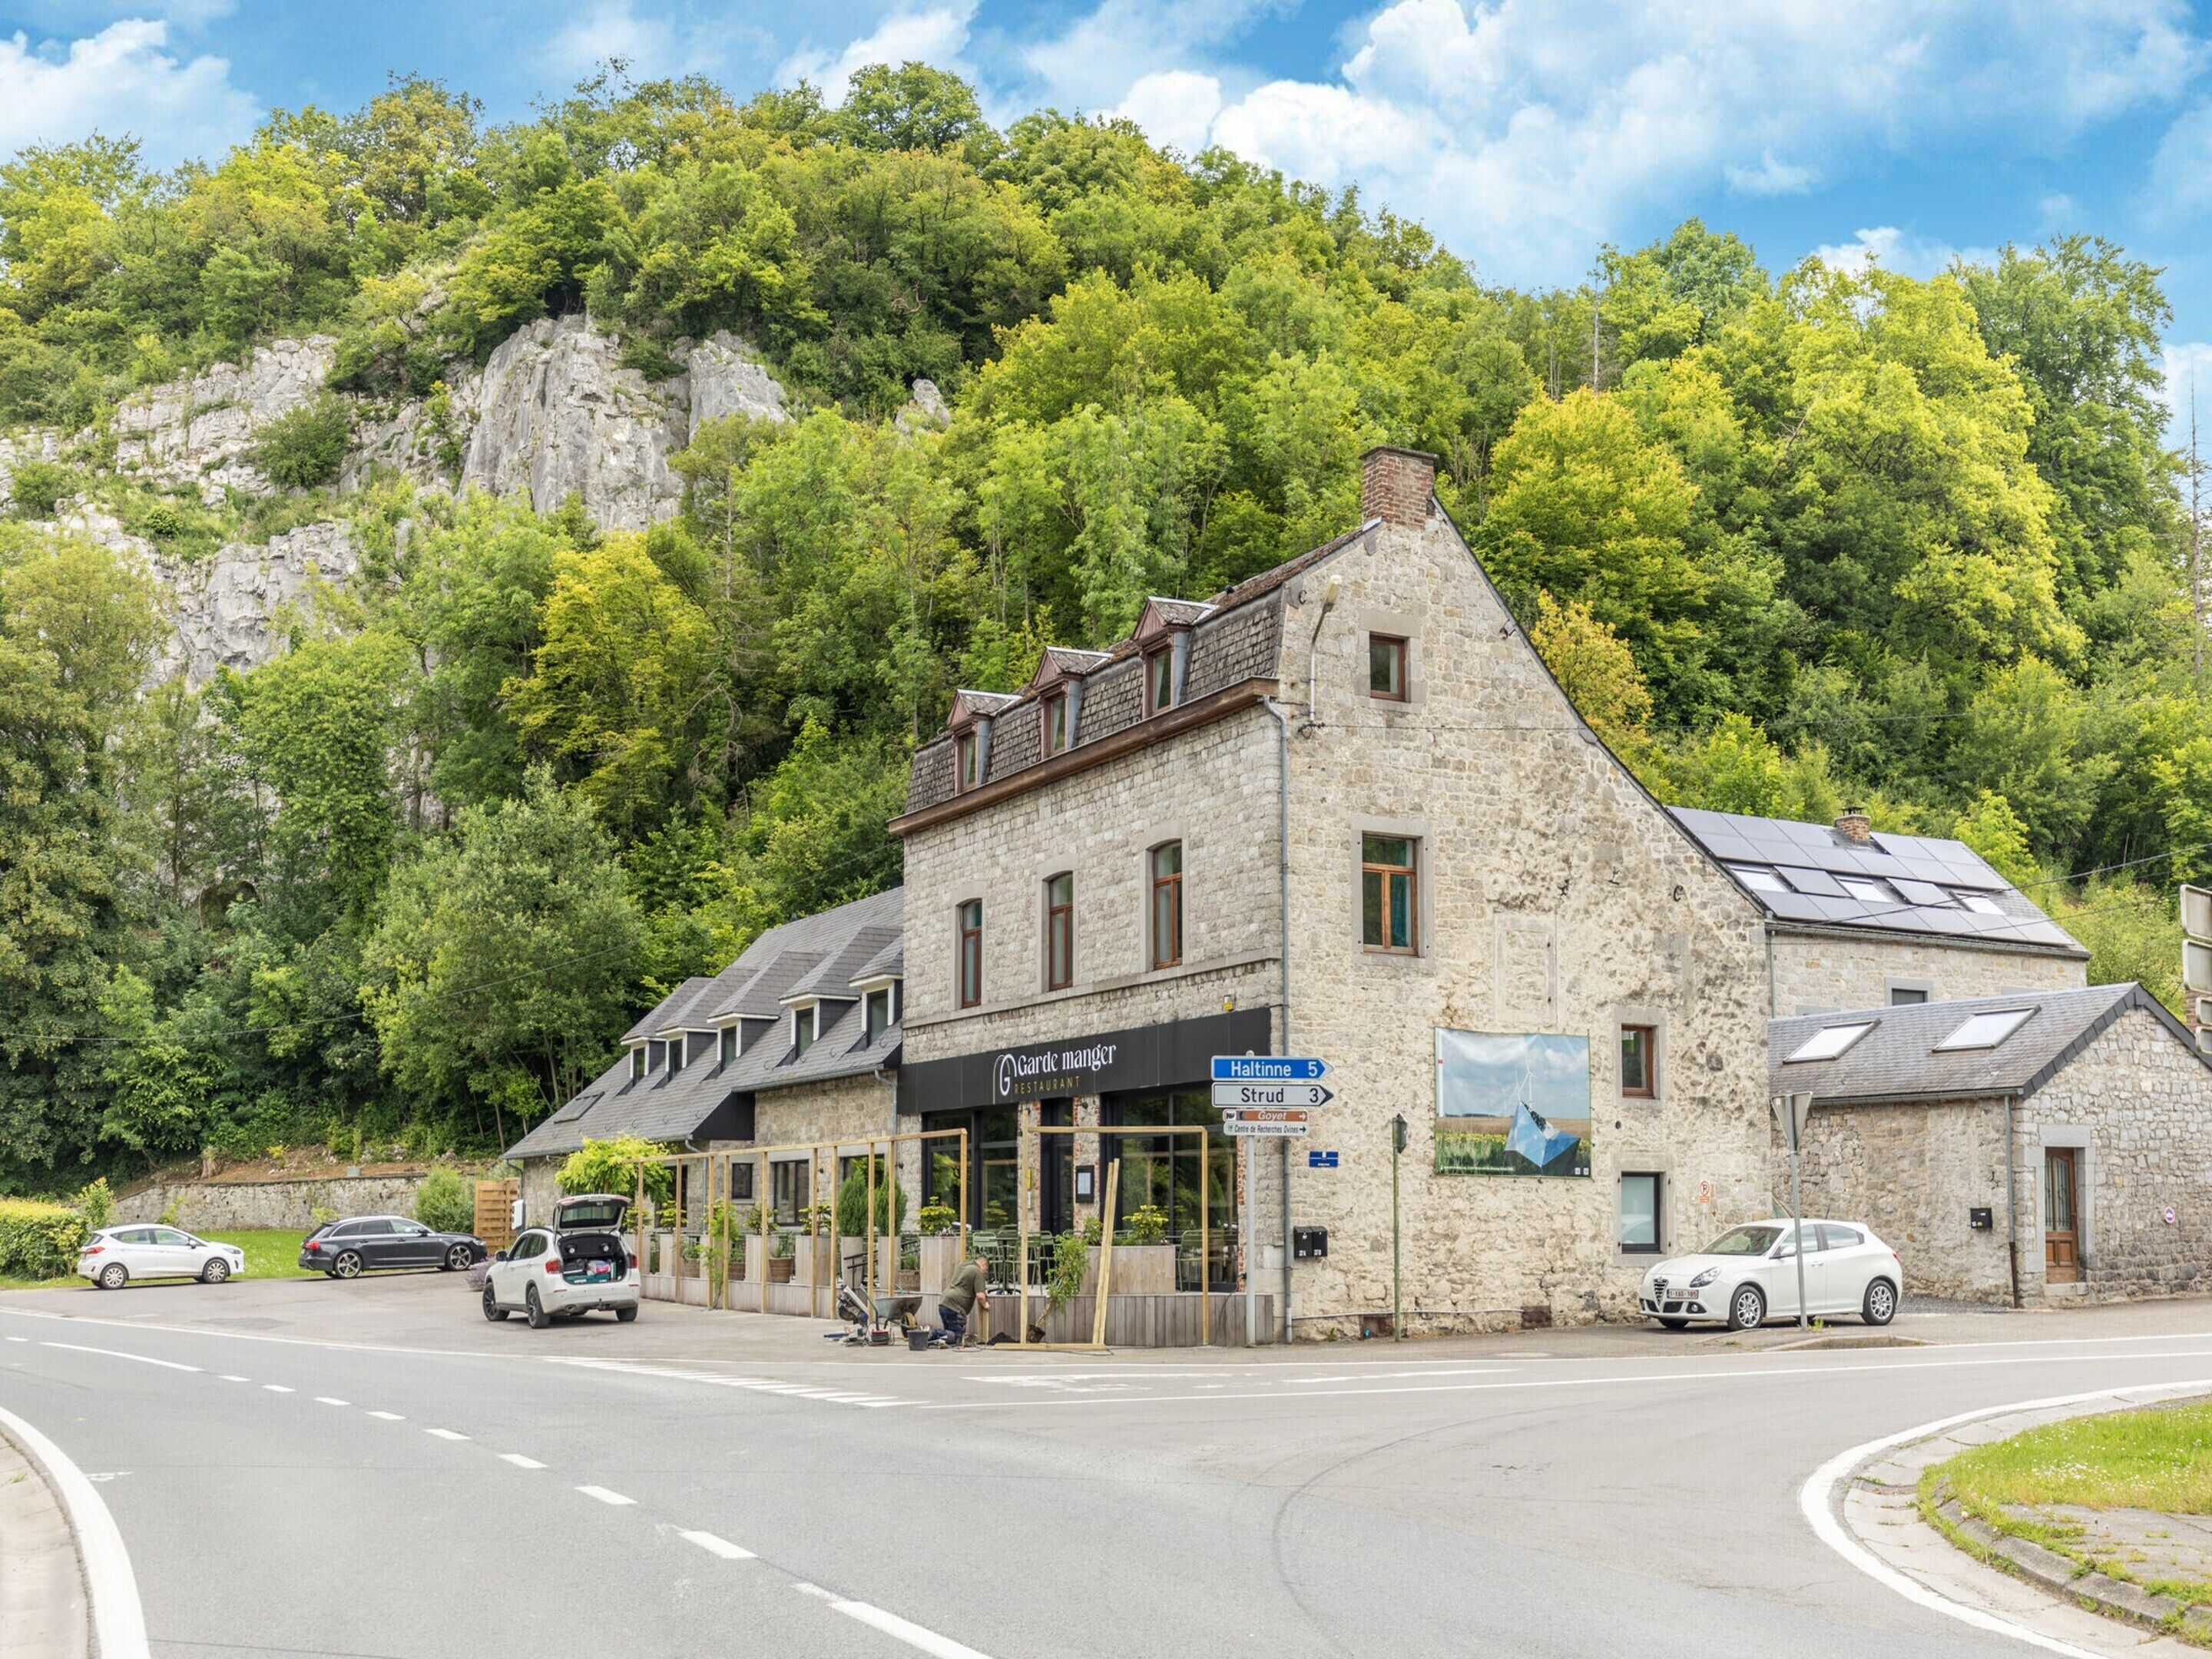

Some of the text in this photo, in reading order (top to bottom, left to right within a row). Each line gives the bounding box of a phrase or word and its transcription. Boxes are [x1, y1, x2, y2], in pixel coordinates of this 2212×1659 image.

[1018, 1043, 1116, 1077] Garde manger
[1230, 1061, 1318, 1077] Haltinne 5
[1013, 1076, 1080, 1094] RESTAURANT
[1241, 1087, 1319, 1103] Strud 3
[1257, 1111, 1286, 1122] Goyet
[1234, 1124, 1249, 1134] Centre
[1250, 1124, 1256, 1133] de
